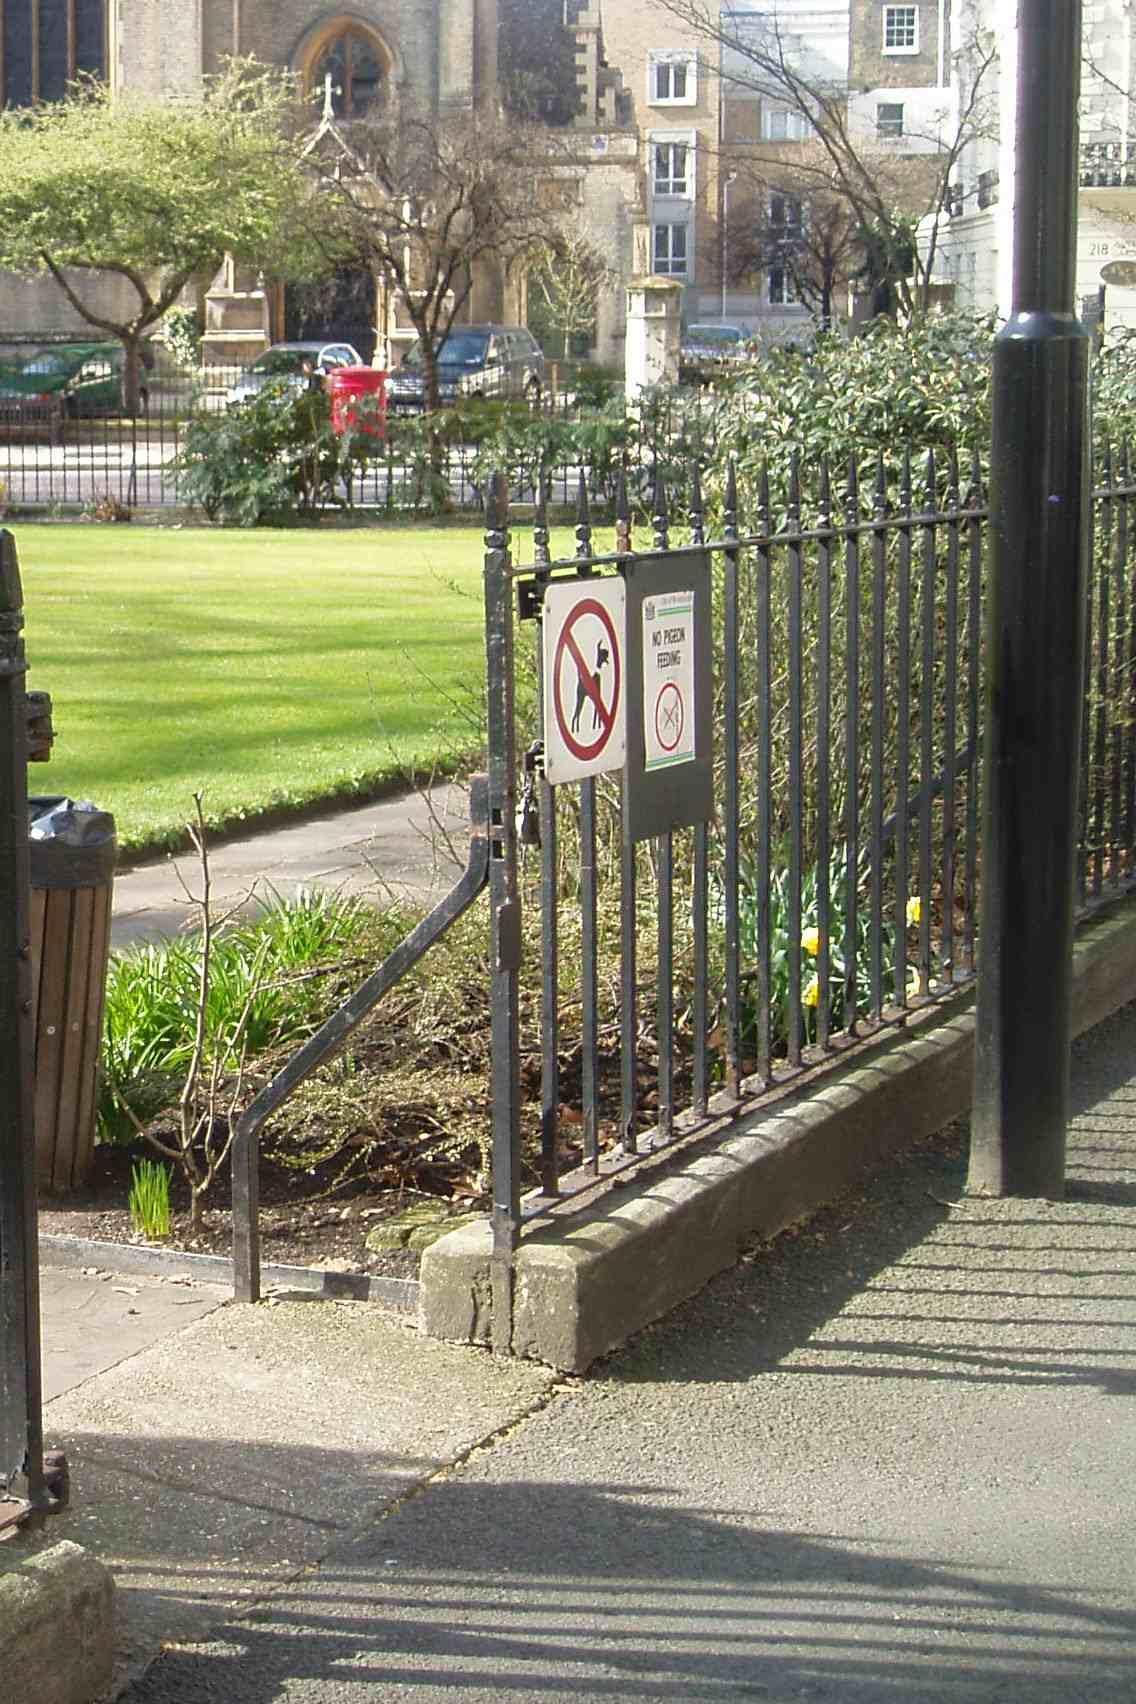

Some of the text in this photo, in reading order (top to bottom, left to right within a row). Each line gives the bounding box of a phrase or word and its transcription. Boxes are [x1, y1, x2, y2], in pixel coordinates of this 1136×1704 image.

[1089, 243, 1109, 256] 218
[652, 627, 685, 647] NO PIGEON
[657, 650, 681, 669] FEEDING
